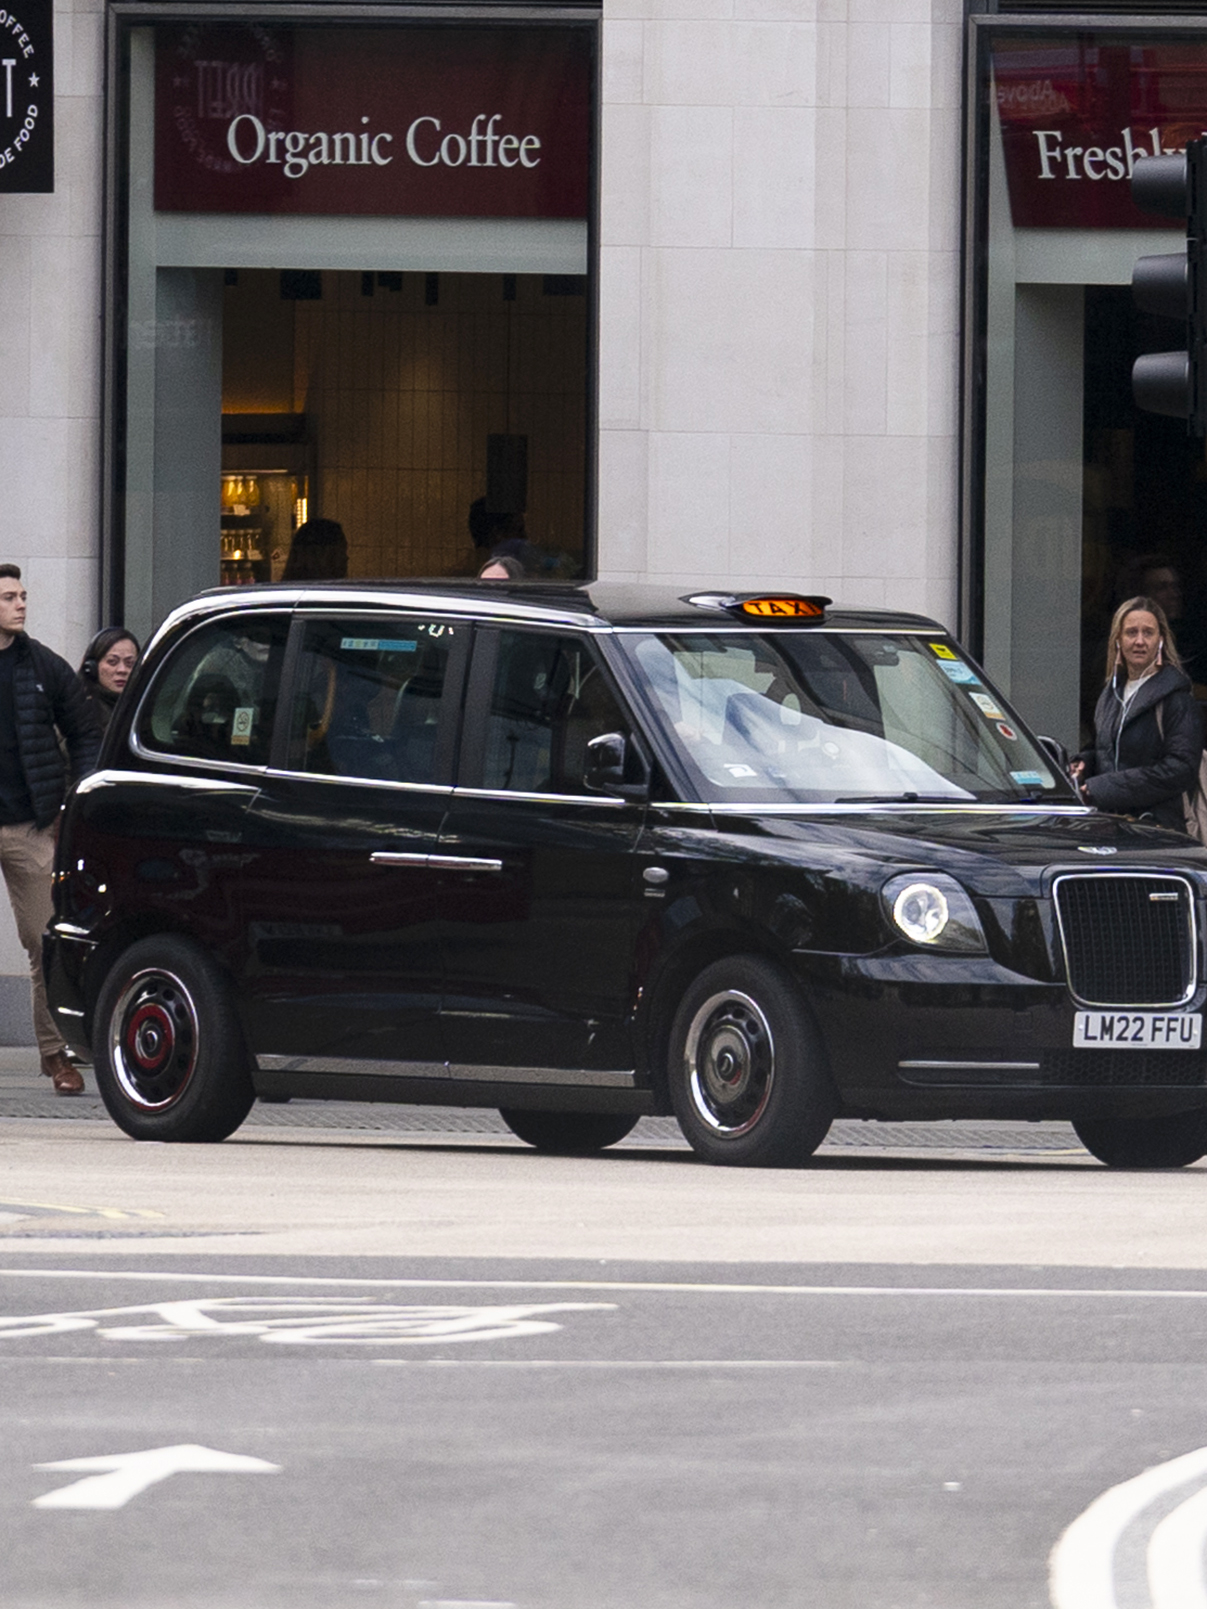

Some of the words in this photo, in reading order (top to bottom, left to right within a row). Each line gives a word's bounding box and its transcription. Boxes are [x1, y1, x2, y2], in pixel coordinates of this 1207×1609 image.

[0, 9, 34, 58] OFFEE
[13, 104, 38, 152] FOOD
[227, 114, 393, 179] Organic
[405, 113, 541, 168] Coffee
[1032, 126, 1188, 181] Freshl
[747, 601, 817, 615] TAXI
[1084, 1014, 1145, 1042] LM22
[1150, 1016, 1194, 1043] FFU
